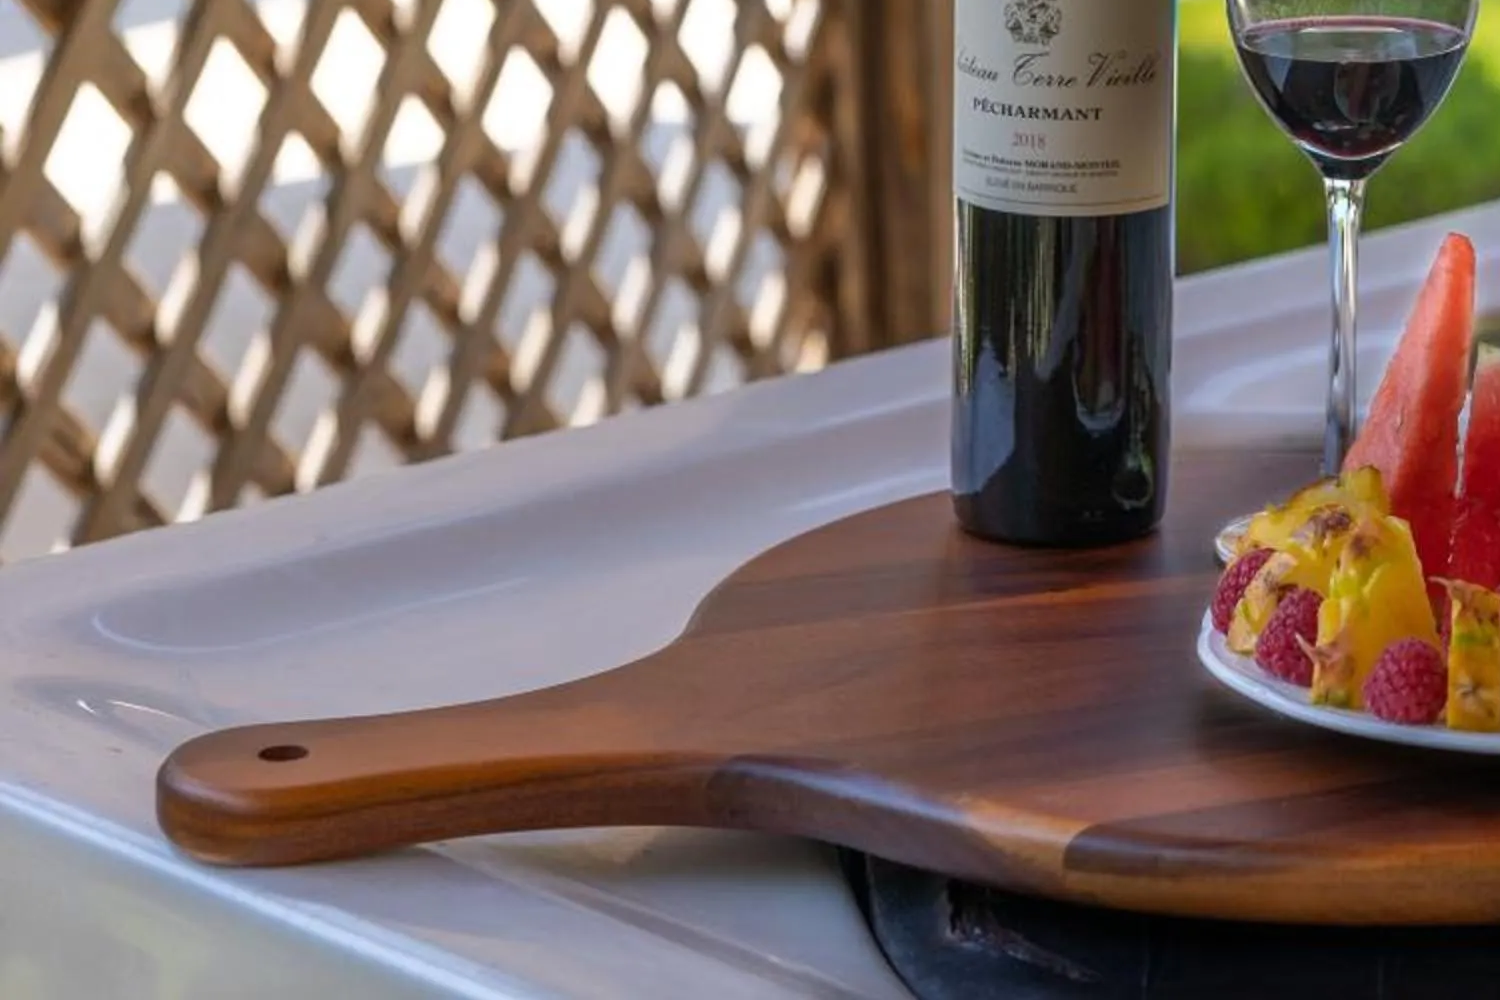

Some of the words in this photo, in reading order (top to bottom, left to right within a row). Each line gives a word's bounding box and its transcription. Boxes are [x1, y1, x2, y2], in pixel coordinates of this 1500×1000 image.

[1012, 52, 1078, 87] Terre
[973, 96, 1103, 121] PÉCHARMANT
[1012, 132, 1046, 150] 2018
